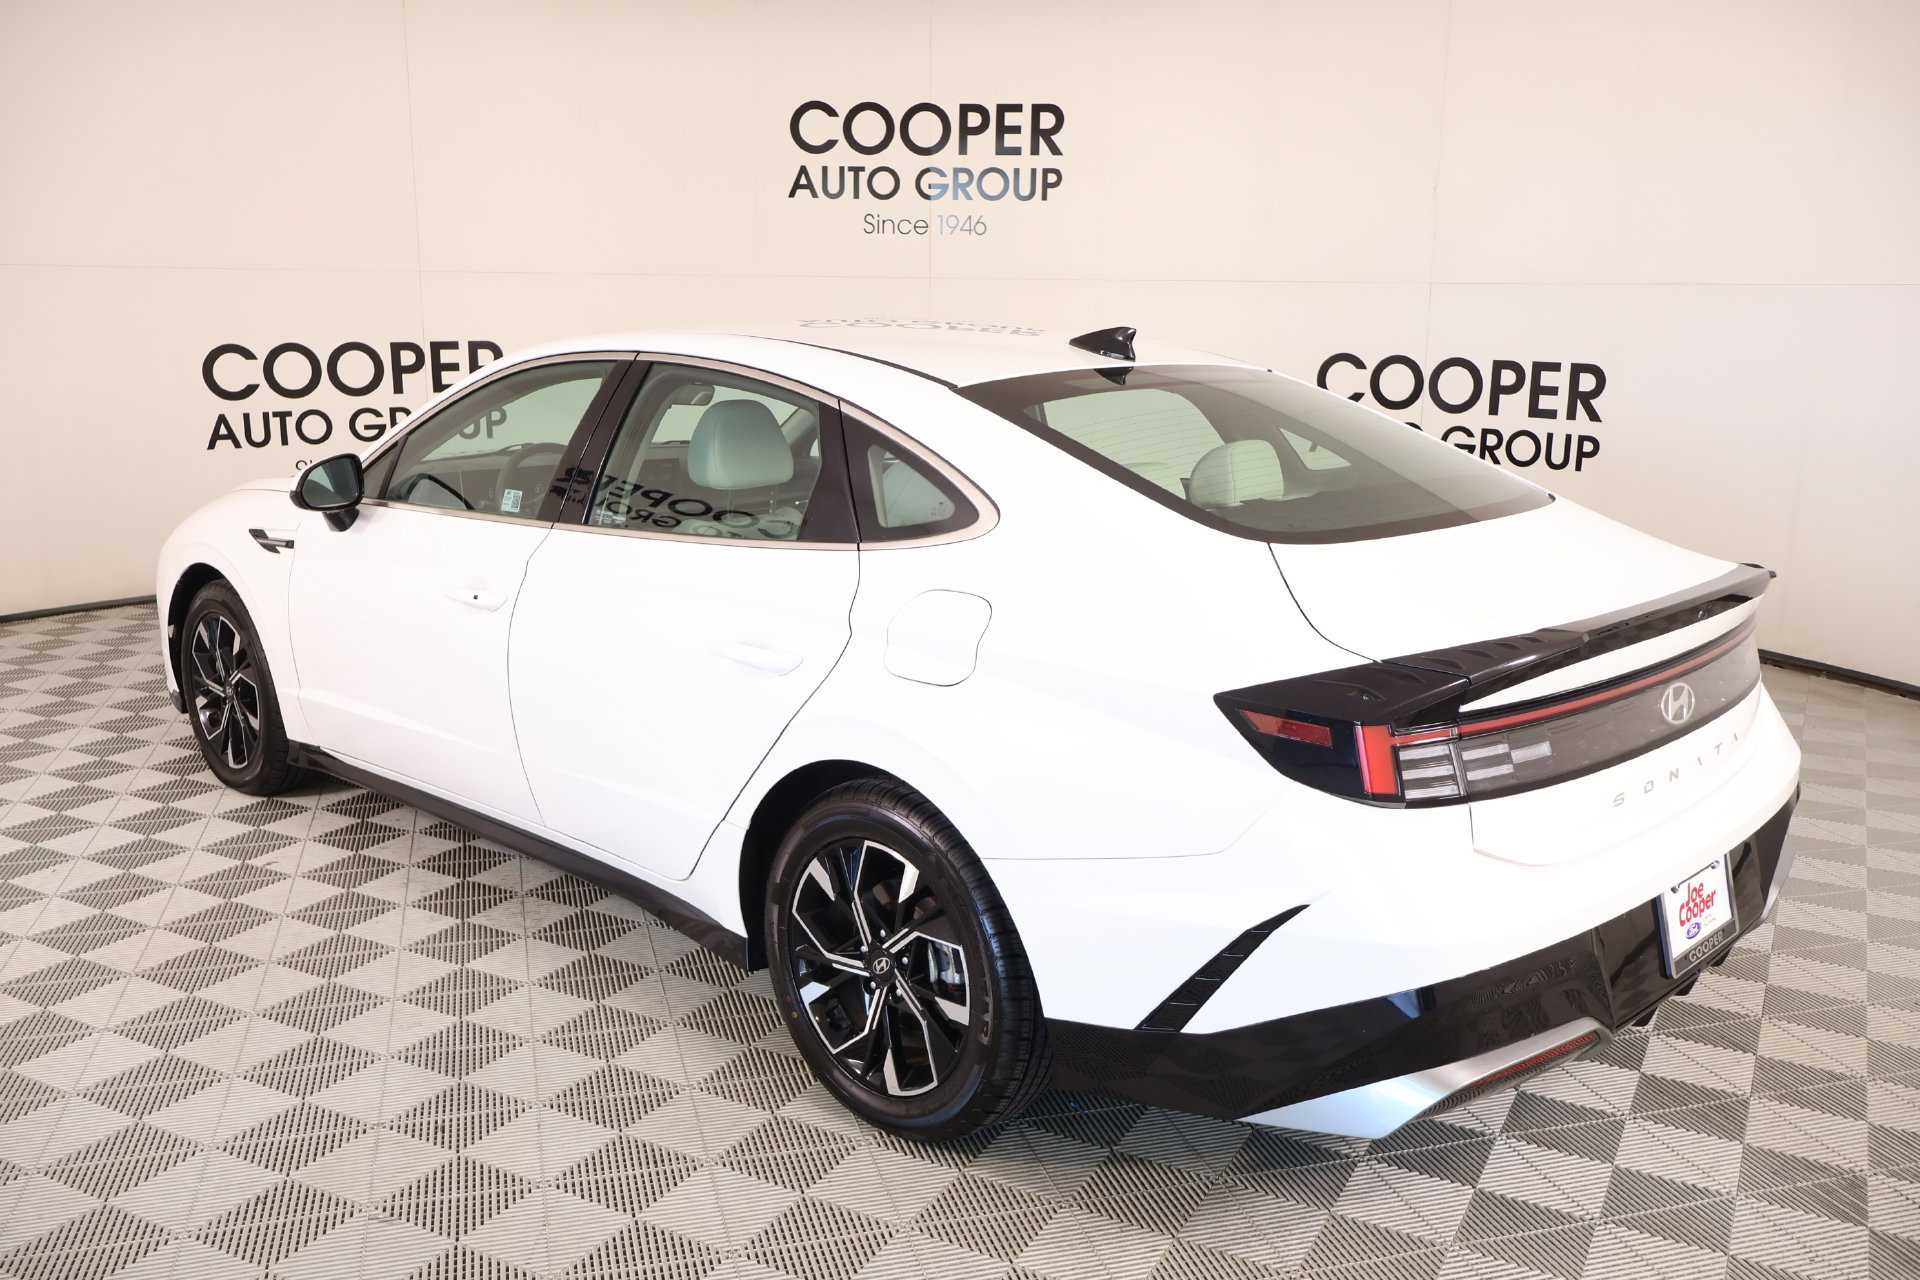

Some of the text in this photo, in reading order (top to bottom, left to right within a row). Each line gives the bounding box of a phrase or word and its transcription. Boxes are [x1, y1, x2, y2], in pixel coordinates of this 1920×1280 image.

[790, 100, 1065, 156] COOPER
[788, 165, 1063, 201] AUTO GROUP
[863, 213, 987, 235] Since 1946
[1317, 352, 1606, 423] COOPER
[207, 409, 333, 450] AUTO
[1441, 425, 1600, 472] GROUP
[1679, 889, 1716, 927] Cooper
[1685, 882, 1704, 907] Joe
[1689, 931, 1724, 962] COOPER
